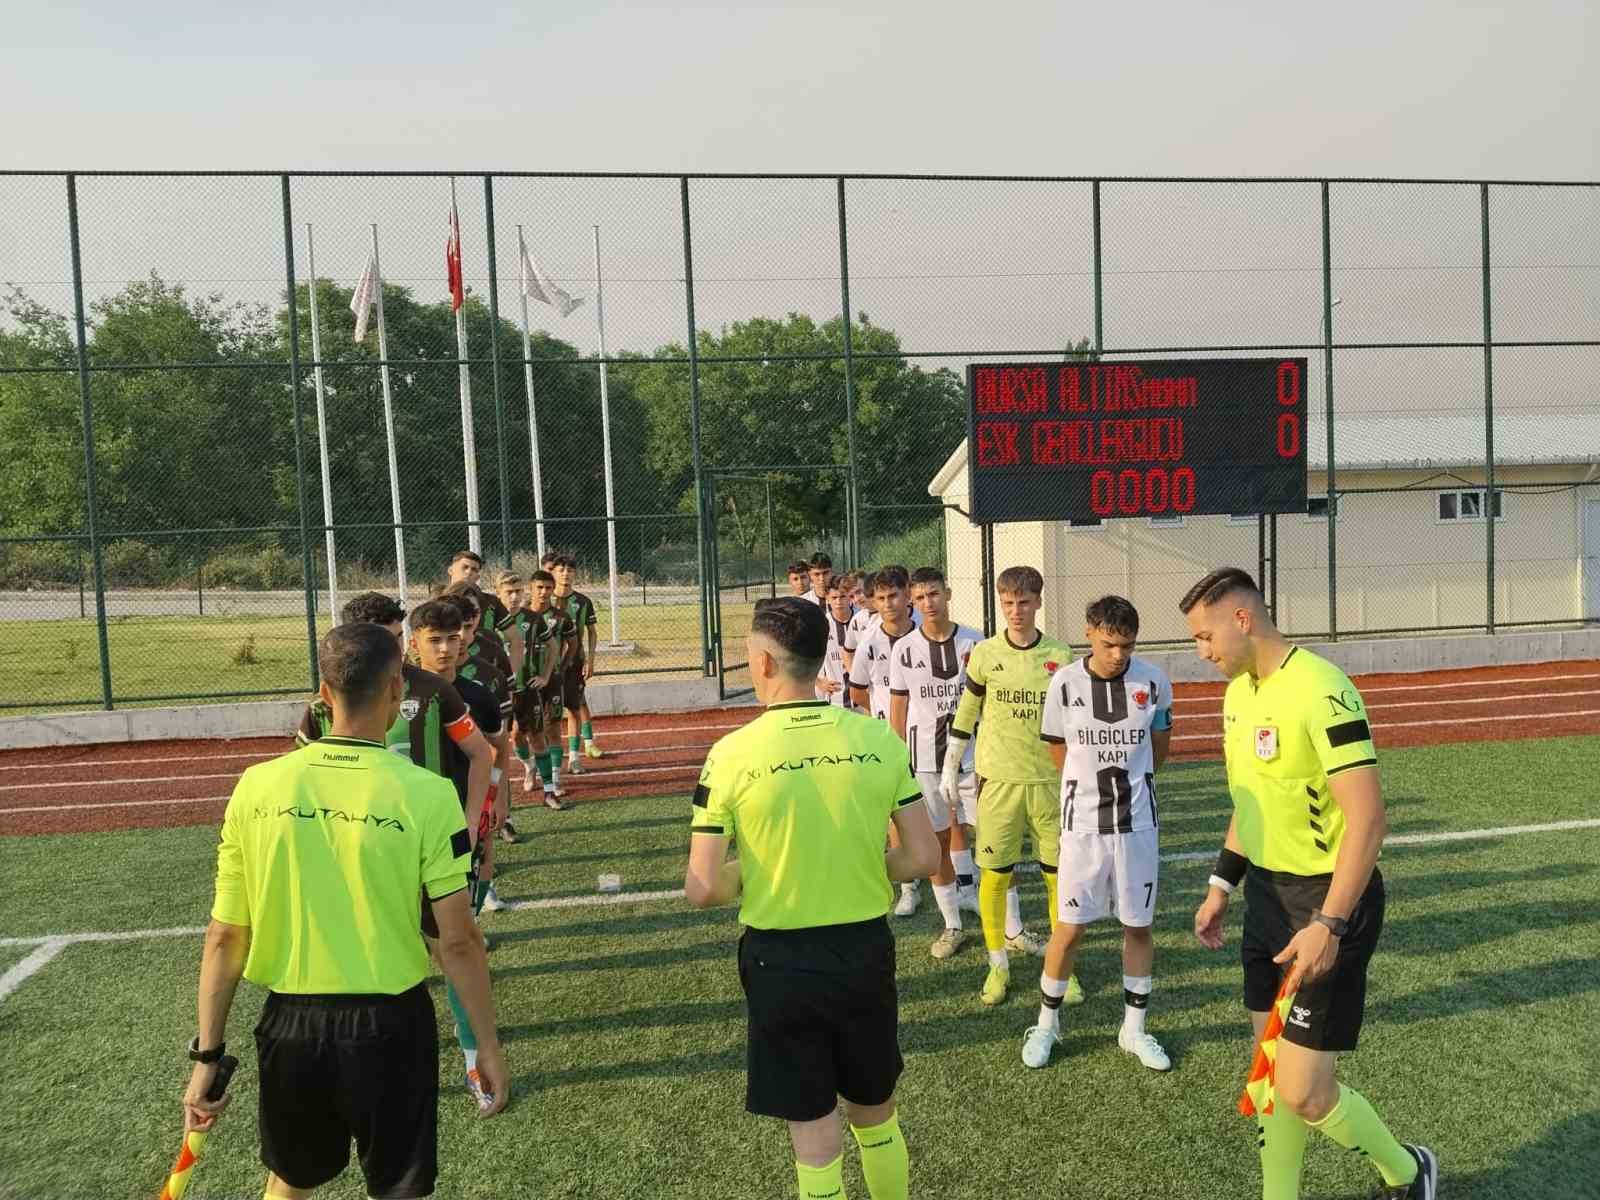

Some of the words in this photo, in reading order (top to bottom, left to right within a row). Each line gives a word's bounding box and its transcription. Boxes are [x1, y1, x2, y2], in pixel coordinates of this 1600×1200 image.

[1276, 361, 1299, 406] 0
[976, 420, 1020, 466] ESK
[1276, 412, 1299, 457] 0
[1091, 467, 1196, 516] 0000
[1012, 708, 1038, 720] KAPI
[323, 752, 360, 762] hummel
[1098, 750, 1128, 763] KAPI
[1143, 882, 1153, 909] 7
